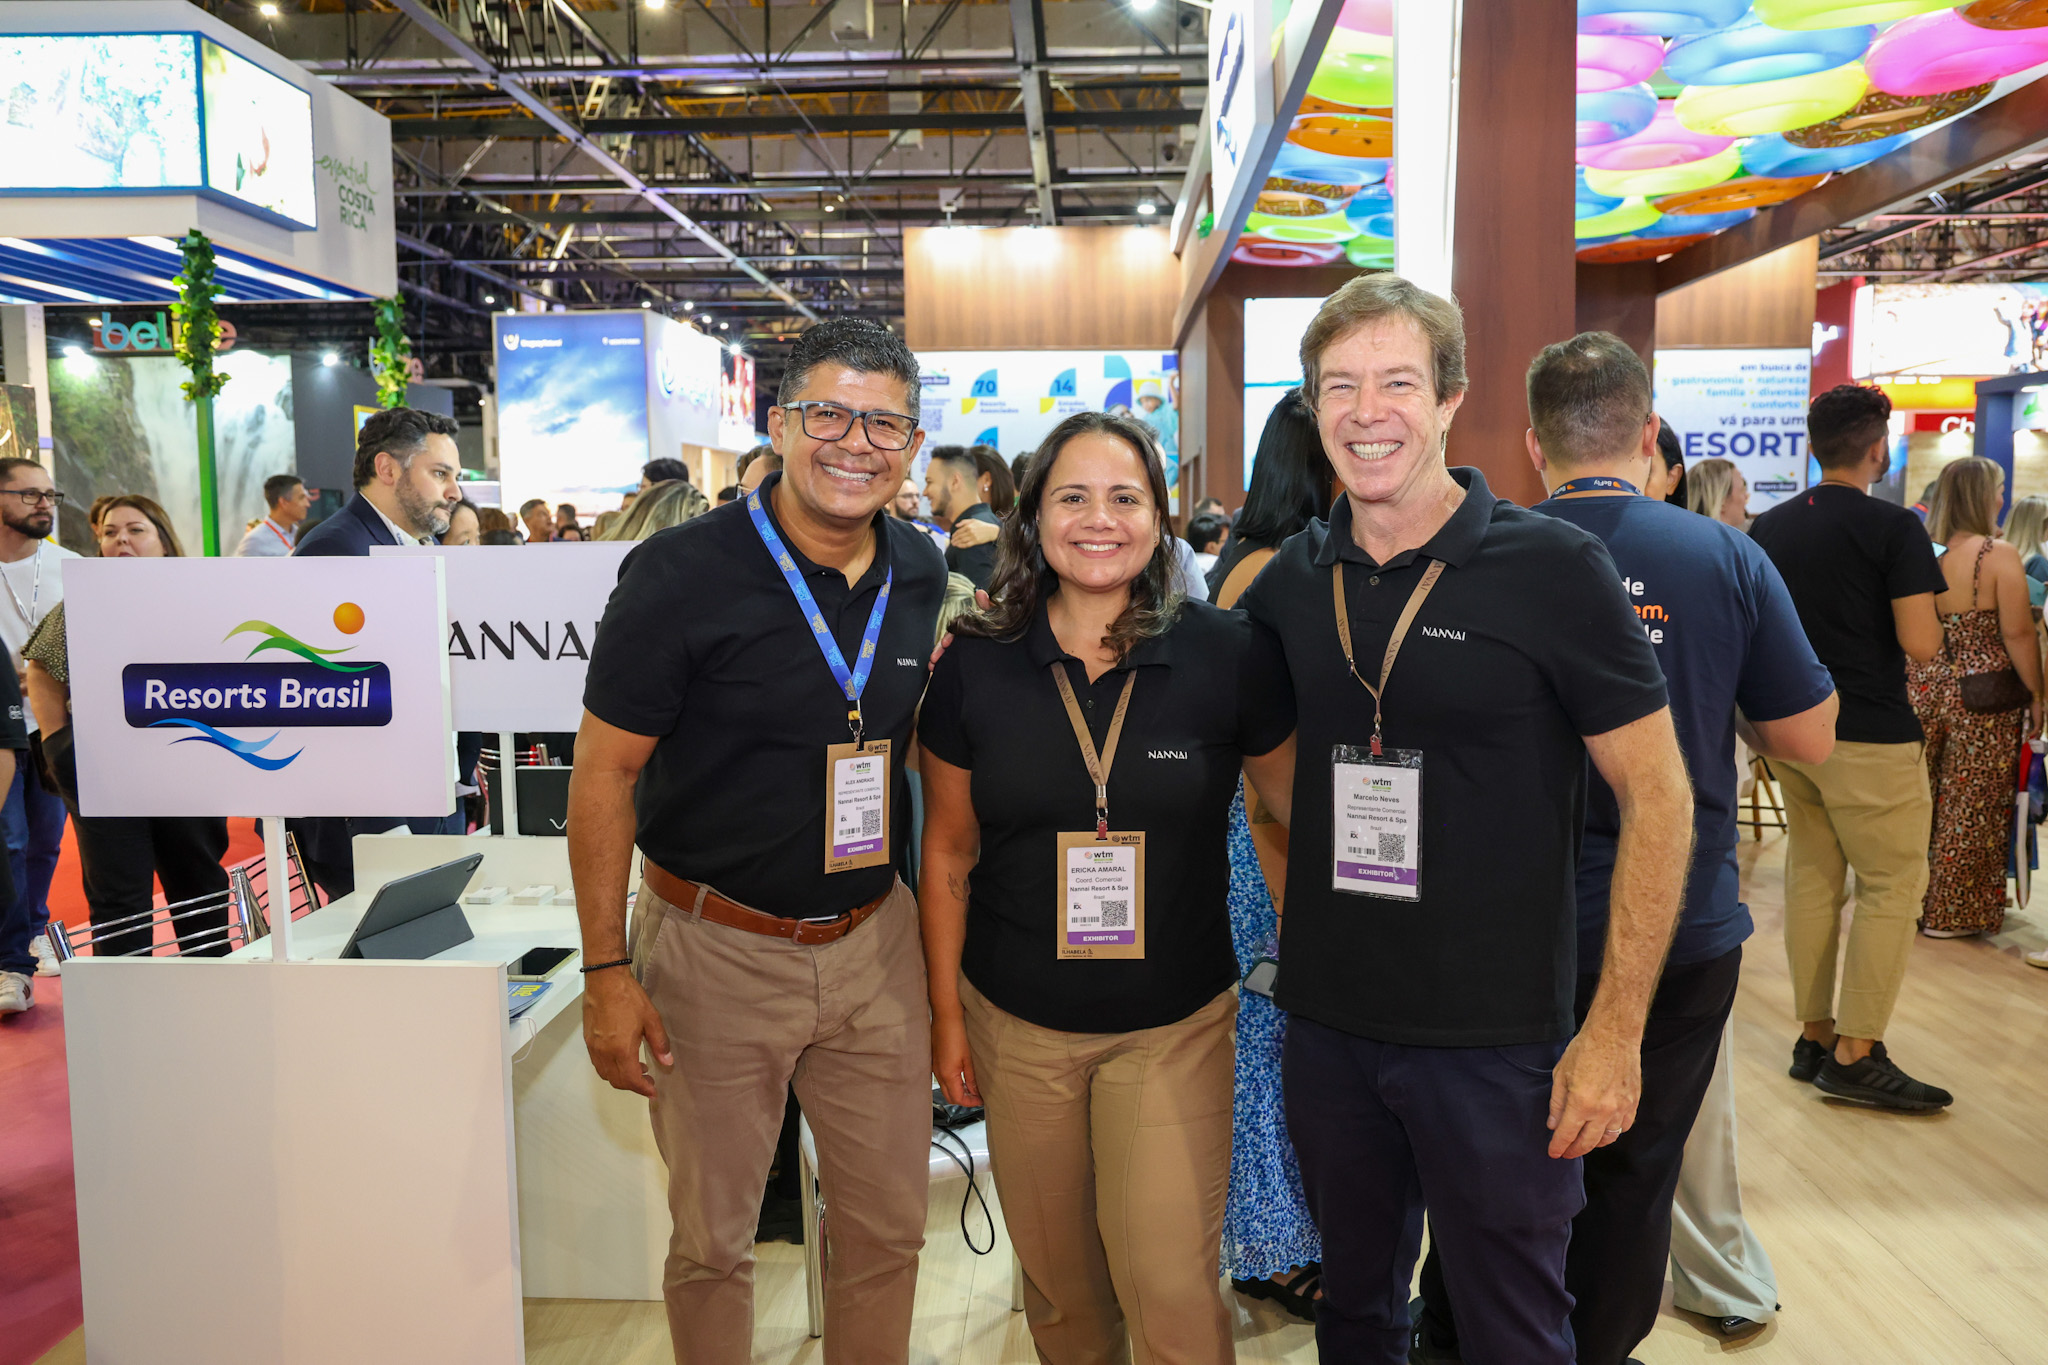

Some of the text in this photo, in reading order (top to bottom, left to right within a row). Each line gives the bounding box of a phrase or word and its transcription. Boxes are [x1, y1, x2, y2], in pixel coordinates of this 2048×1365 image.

[339, 184, 376, 216] COSTA
[341, 205, 367, 232] RICA
[101, 311, 237, 350] belie
[1760, 363, 1791, 371] busca
[1795, 363, 1808, 371] de
[1054, 379, 1074, 393] 14
[1672, 376, 1808, 386] gastronomia natureza
[975, 380, 997, 394] 70
[1759, 387, 1808, 397] diversão
[1720, 414, 1806, 428] vá para um
[1676, 432, 1805, 457] ESORT
[1593, 479, 1613, 487] BeFly
[1420, 562, 1443, 591] ANNAI
[1422, 626, 1466, 641] NANNAI
[448, 620, 601, 660] ANNA
[144, 677, 371, 710] Resorts Brasil
[1148, 750, 1188, 760] NANNAI
[1371, 778, 1392, 786] wtm
[1353, 793, 1379, 802] Marcelo
[1347, 804, 1381, 813] Representante
[1368, 814, 1388, 822] Resort
[1395, 816, 1407, 824] Spa
[1121, 834, 1141, 842] wtm
[847, 843, 874, 854] EXHIBITOR
[1358, 868, 1394, 878] EXHIBITOR
[1117, 884, 1129, 892] Spa
